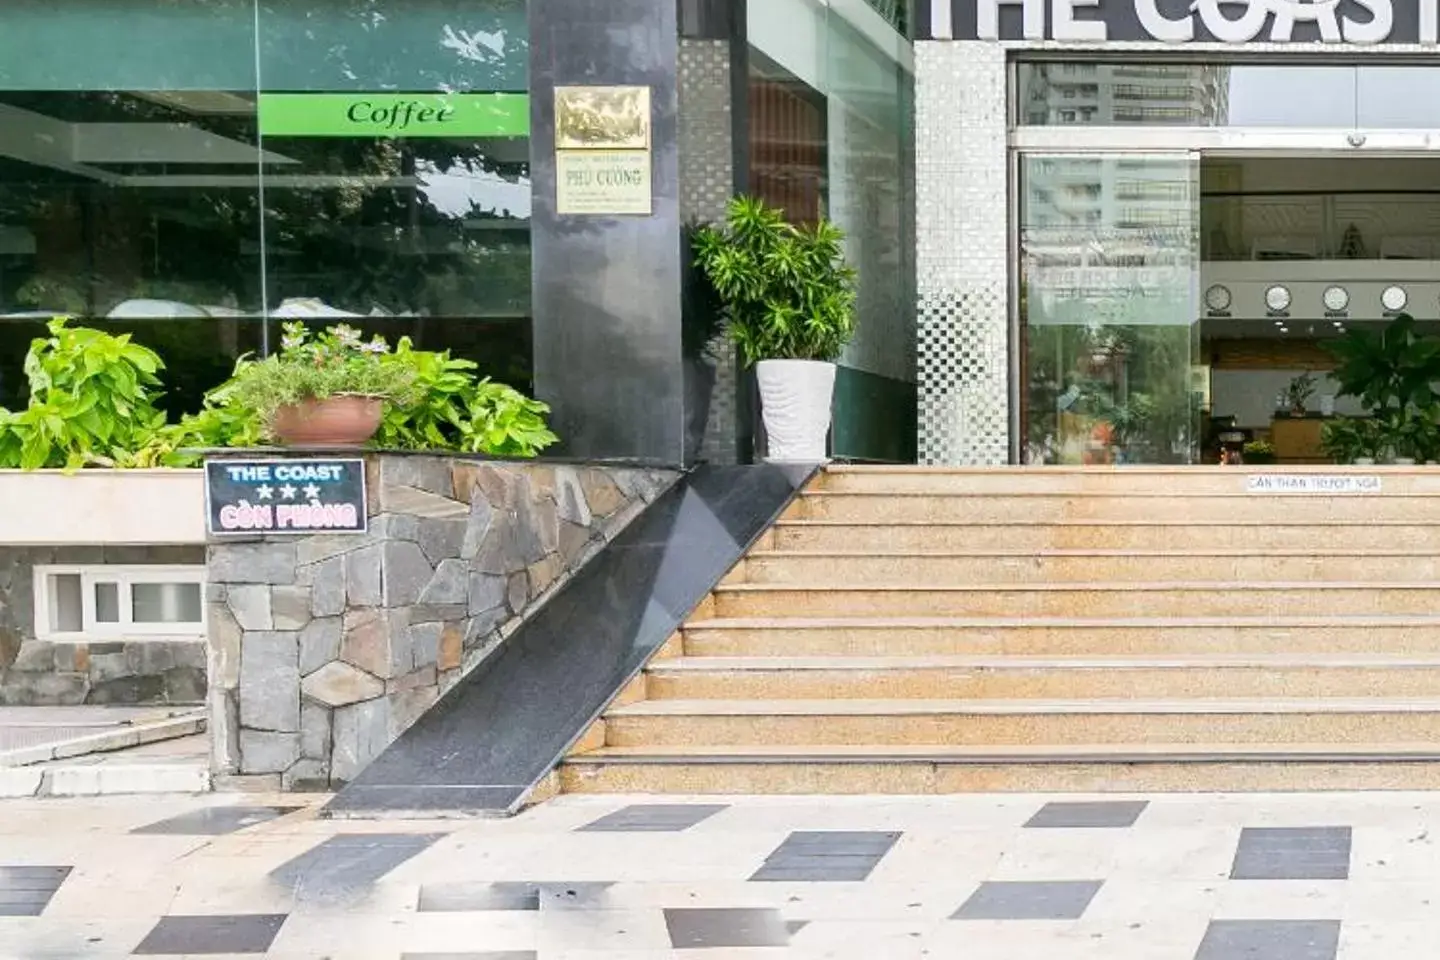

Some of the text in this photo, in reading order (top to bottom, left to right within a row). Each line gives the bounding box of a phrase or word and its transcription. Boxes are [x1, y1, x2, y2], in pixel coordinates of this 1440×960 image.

[347, 101, 455, 129] Coffee
[227, 465, 343, 481] THE COAST
